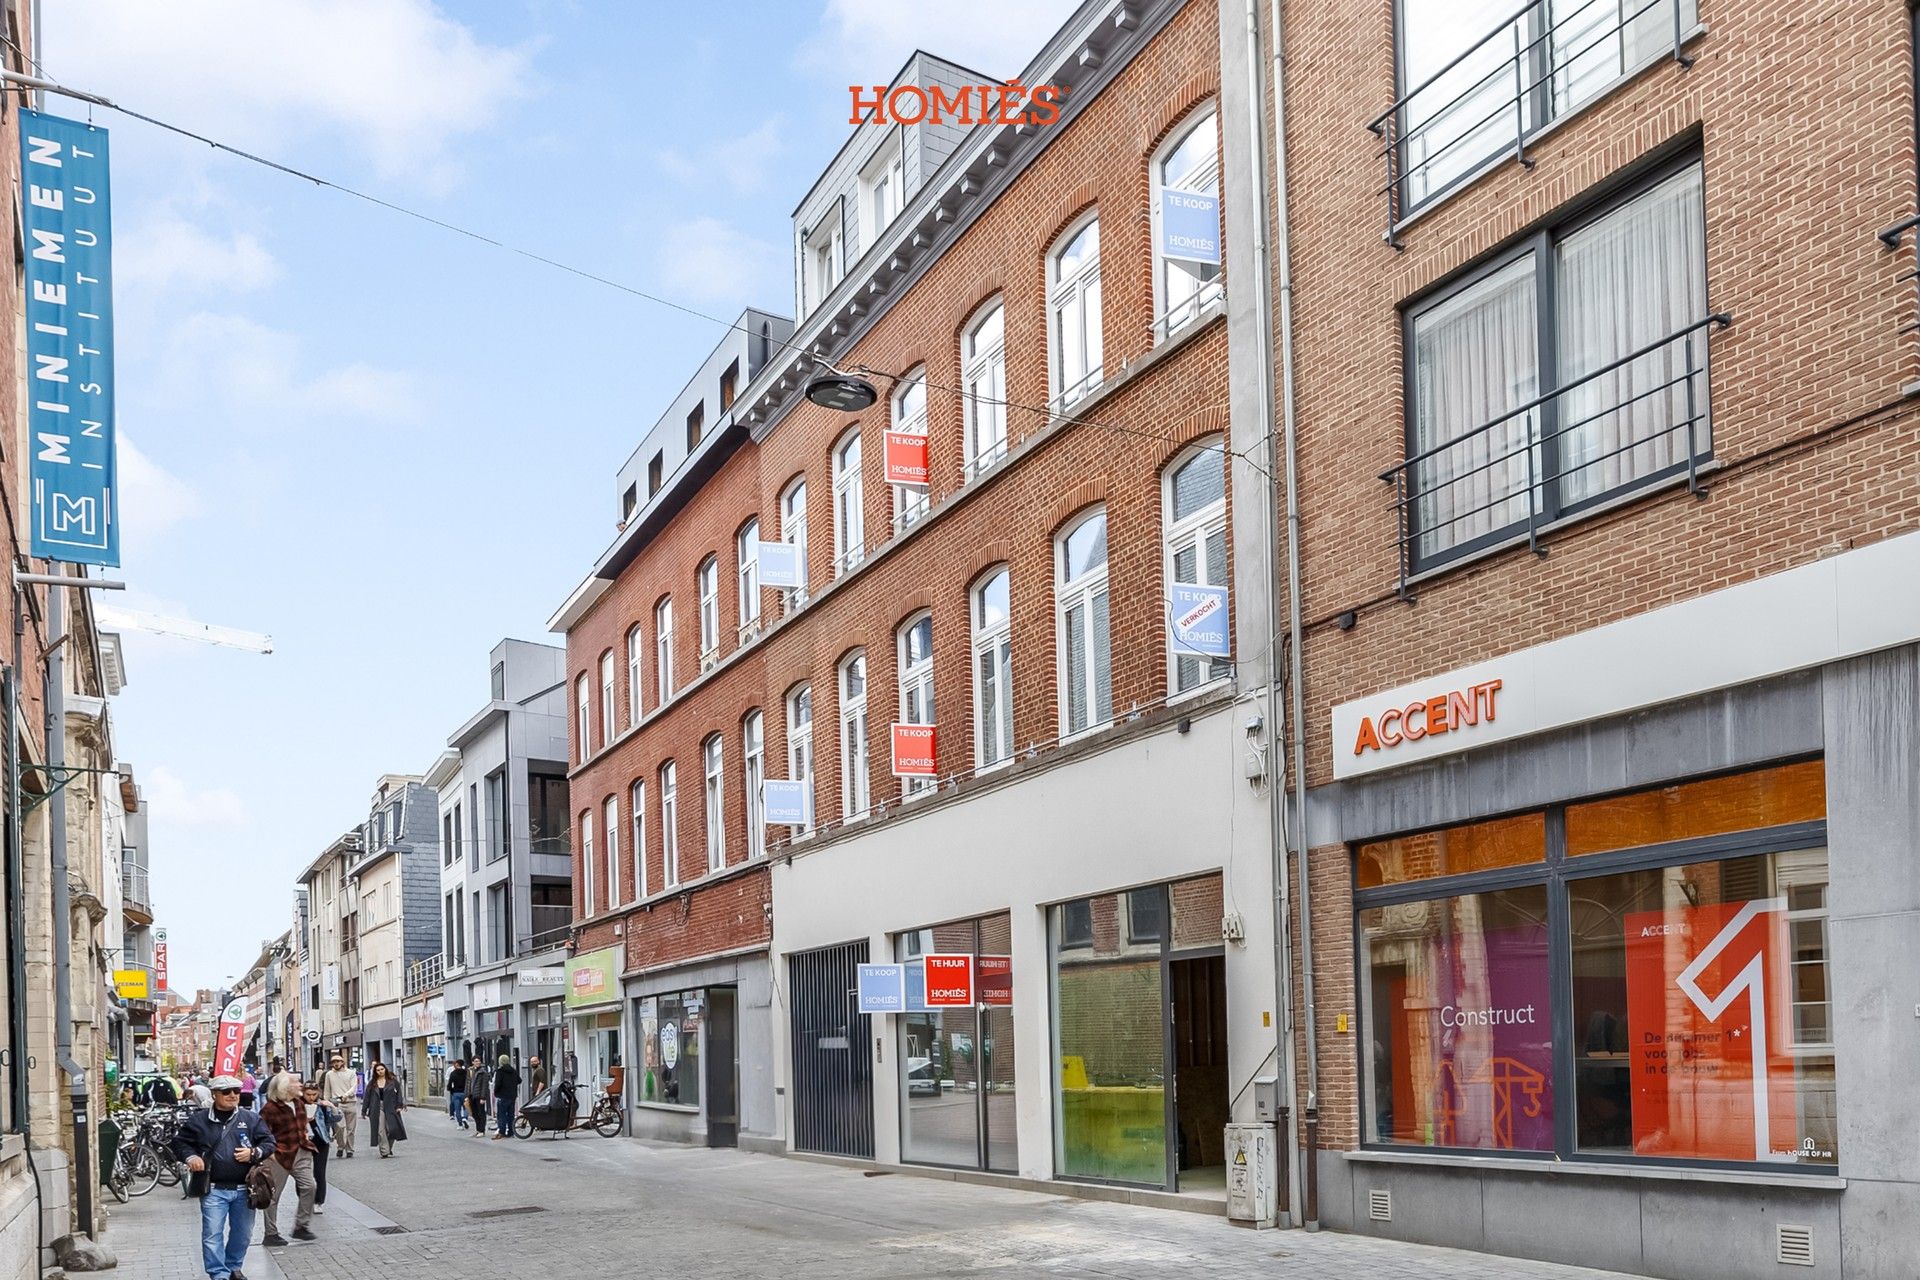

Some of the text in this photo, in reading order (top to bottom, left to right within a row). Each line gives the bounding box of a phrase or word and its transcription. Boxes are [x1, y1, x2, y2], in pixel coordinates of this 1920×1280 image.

[1168, 195, 1213, 210] TE KOOP
[28, 135, 71, 465] MINIEMEN
[72, 145, 103, 469] INSTITUUT
[902, 438, 926, 446] KOOP
[1178, 591, 1191, 600] TE
[1181, 600, 1217, 627] VERKOCHT
[1353, 679, 1502, 755] ACCENT
[1641, 923, 1686, 937] ACCENT
[157, 944, 167, 980] SPAR
[931, 960, 965, 968] TE HUUR
[864, 969, 897, 977] TE KOOP
[1440, 1004, 1535, 1027] Construct
[1644, 1032, 1662, 1044] De
[223, 1025, 239, 1072] PAR
[1645, 1062, 1657, 1074] in
